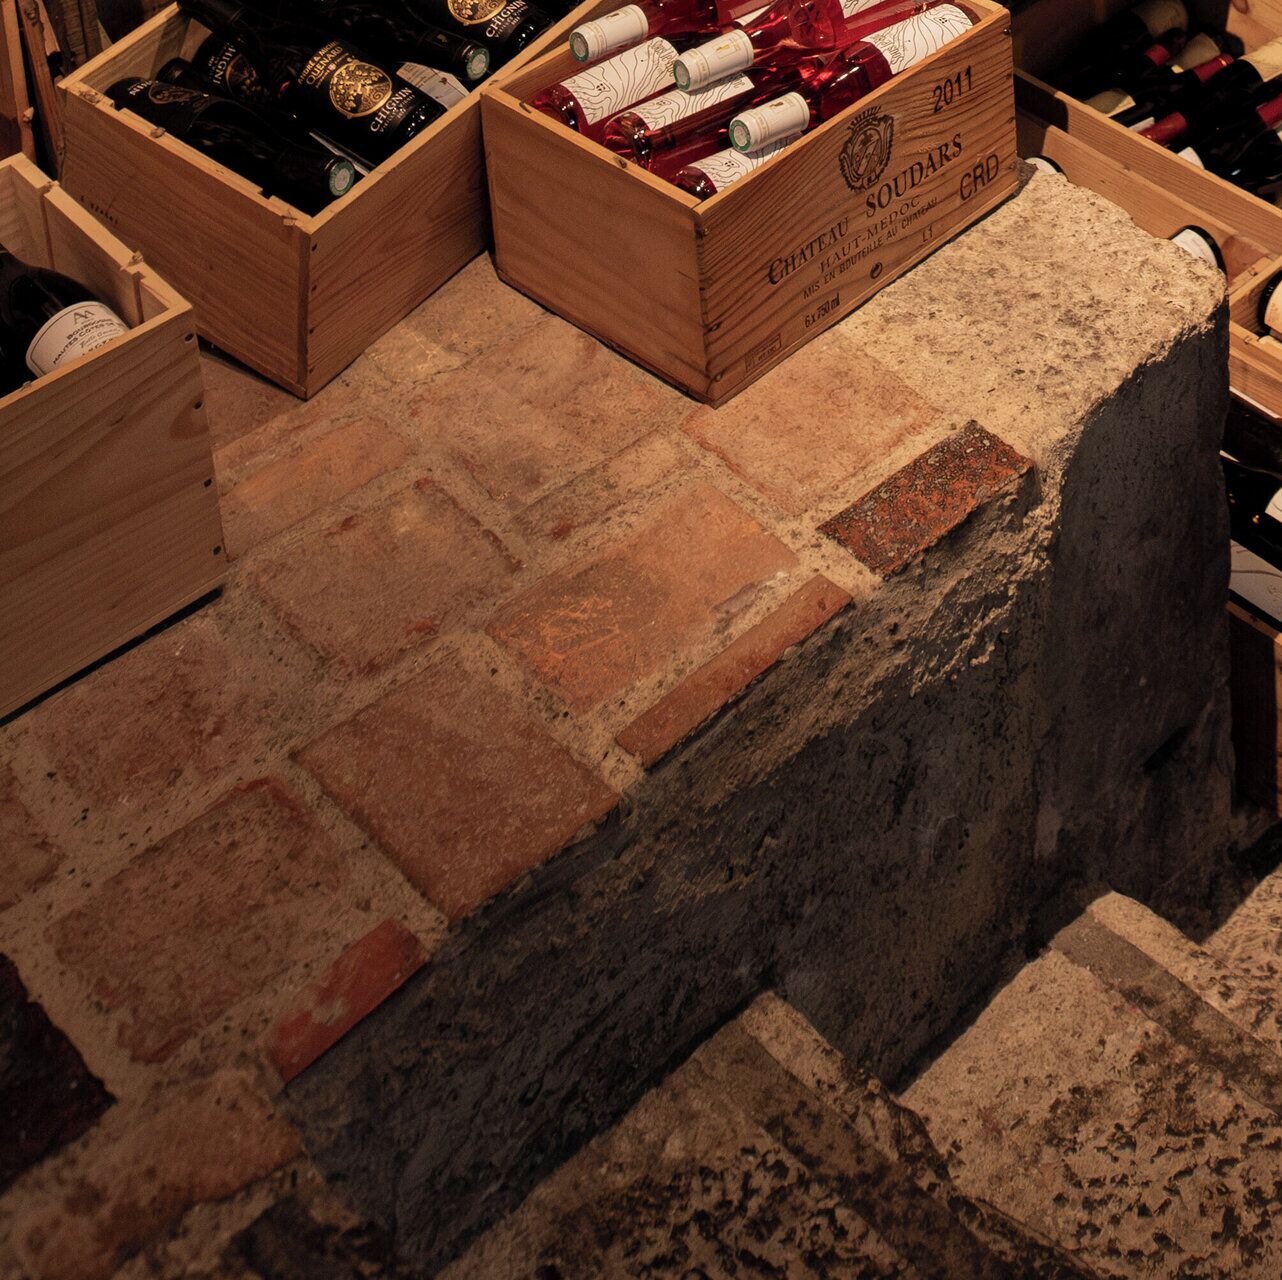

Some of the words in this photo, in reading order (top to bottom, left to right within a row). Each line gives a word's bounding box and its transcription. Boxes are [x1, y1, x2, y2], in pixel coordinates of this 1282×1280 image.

[304, 44, 343, 86] QUENARD
[929, 64, 979, 113] 2011
[368, 86, 413, 133] CHIGNIN
[954, 151, 1005, 203] CRD
[763, 216, 852, 286] CHATEAU
[862, 132, 967, 218] SOUDARS
[817, 194, 923, 273] HAUT-MEDOC
[801, 279, 822, 299] MIS
[823, 268, 839, 284] EN
[838, 233, 887, 273] BOUTEILLE
[885, 224, 899, 240] AU
